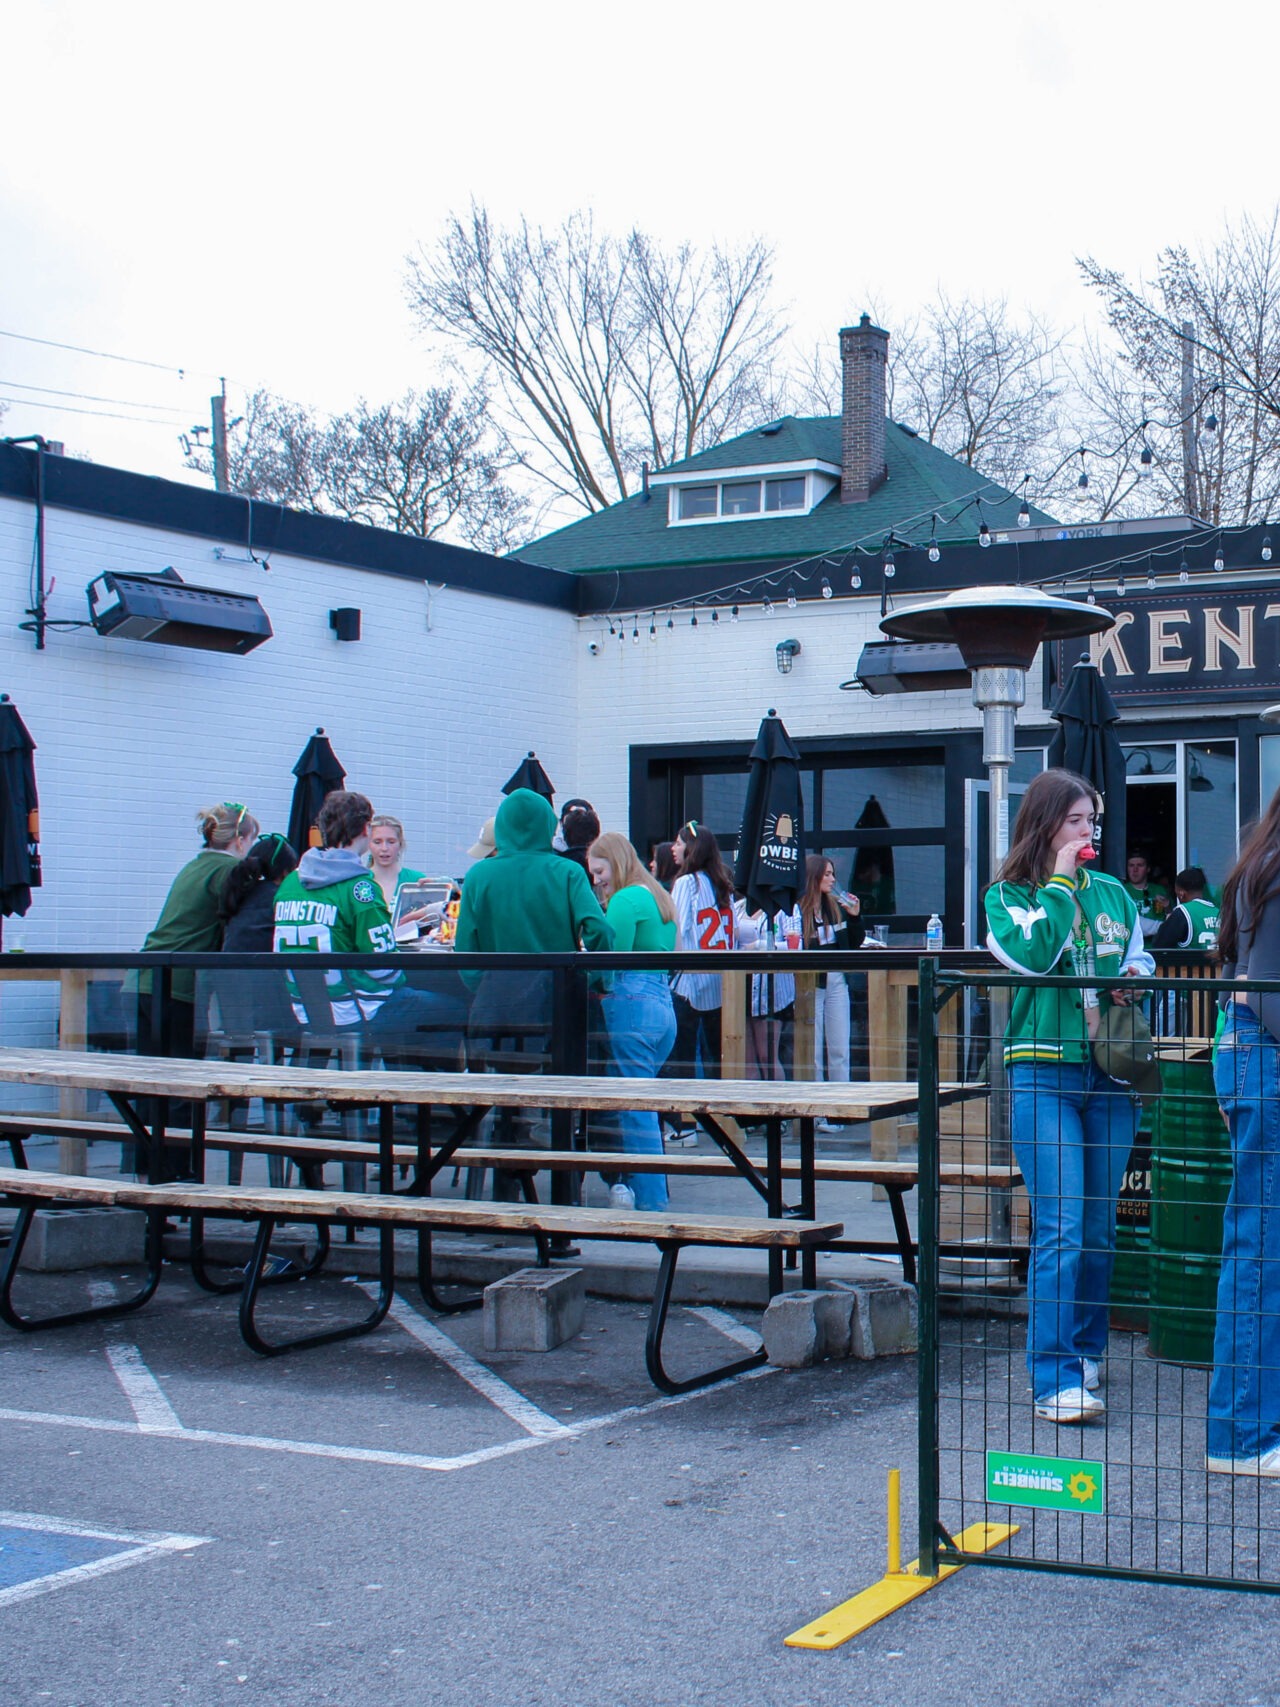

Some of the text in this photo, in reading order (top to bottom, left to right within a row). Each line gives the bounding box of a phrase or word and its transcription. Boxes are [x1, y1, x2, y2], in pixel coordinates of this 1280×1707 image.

[1068, 527, 1104, 539] YORK
[763, 859, 791, 871] BREWING
[275, 900, 337, 927] JOHNSTON
[368, 923, 396, 953] 53
[1002, 1465, 1054, 1477] RENTALS
[993, 1470, 1063, 1492] SUNBELT
